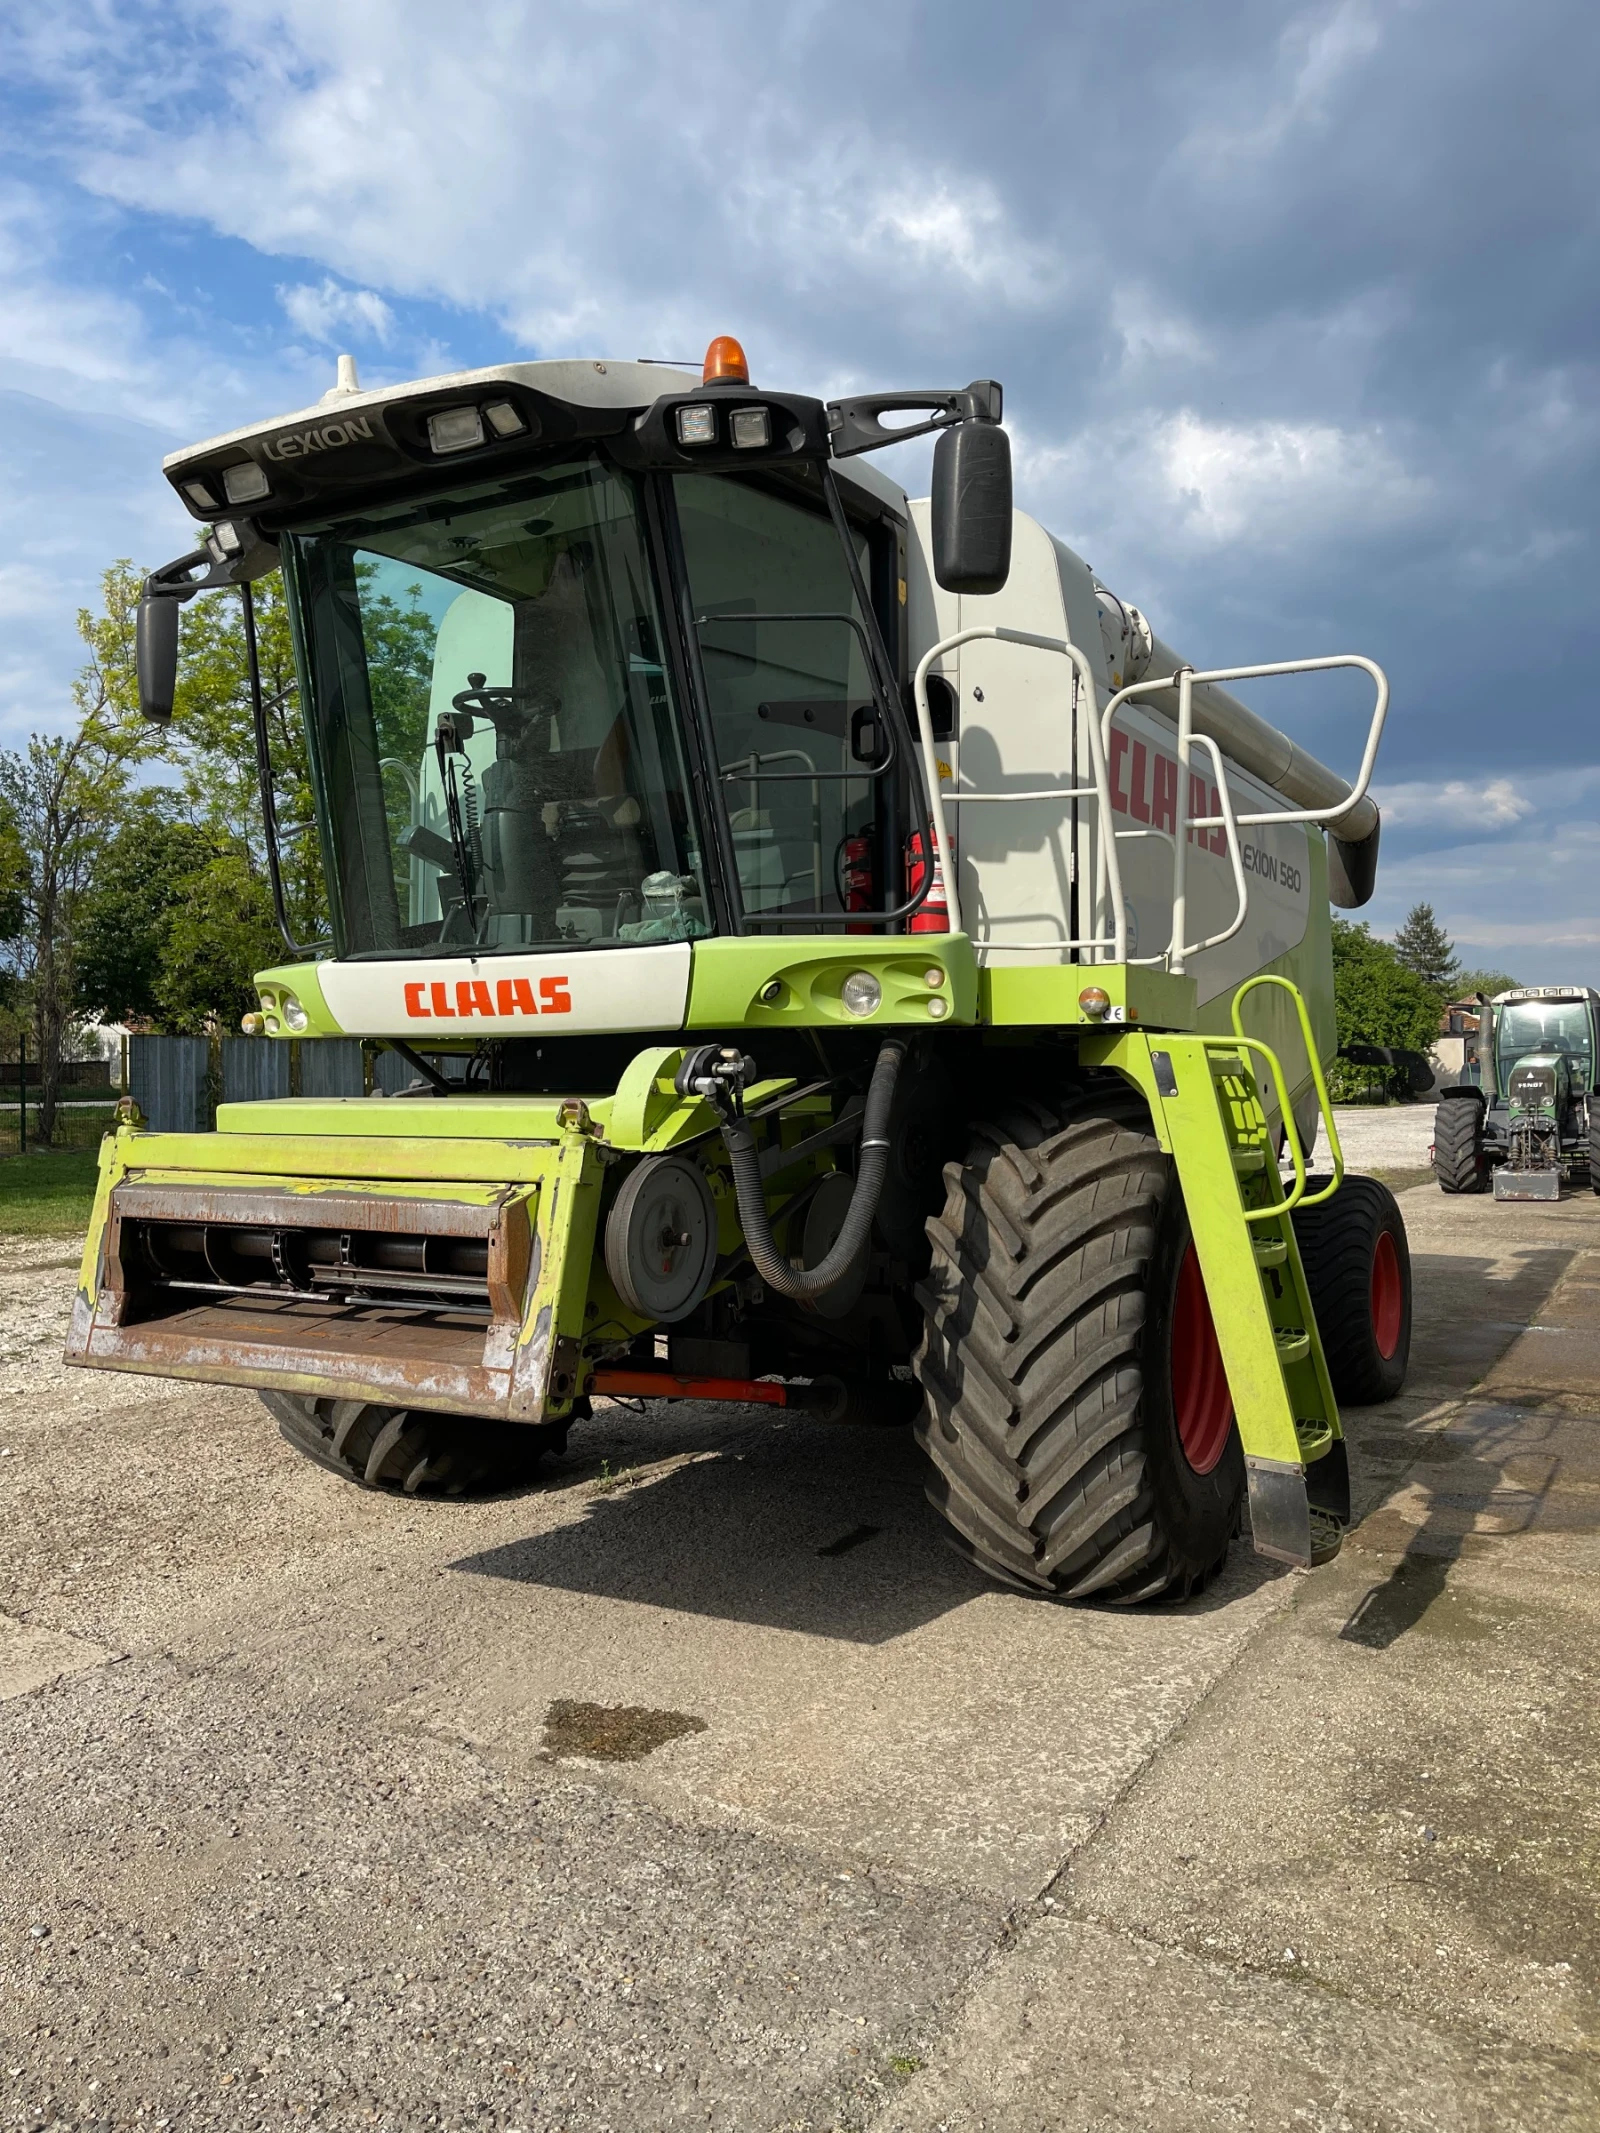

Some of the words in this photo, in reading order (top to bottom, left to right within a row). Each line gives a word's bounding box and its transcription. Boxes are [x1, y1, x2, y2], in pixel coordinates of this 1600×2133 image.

[262, 417, 374, 460] LEXION
[1280, 861, 1301, 893] 580
[404, 976, 571, 1017] CLAAS
